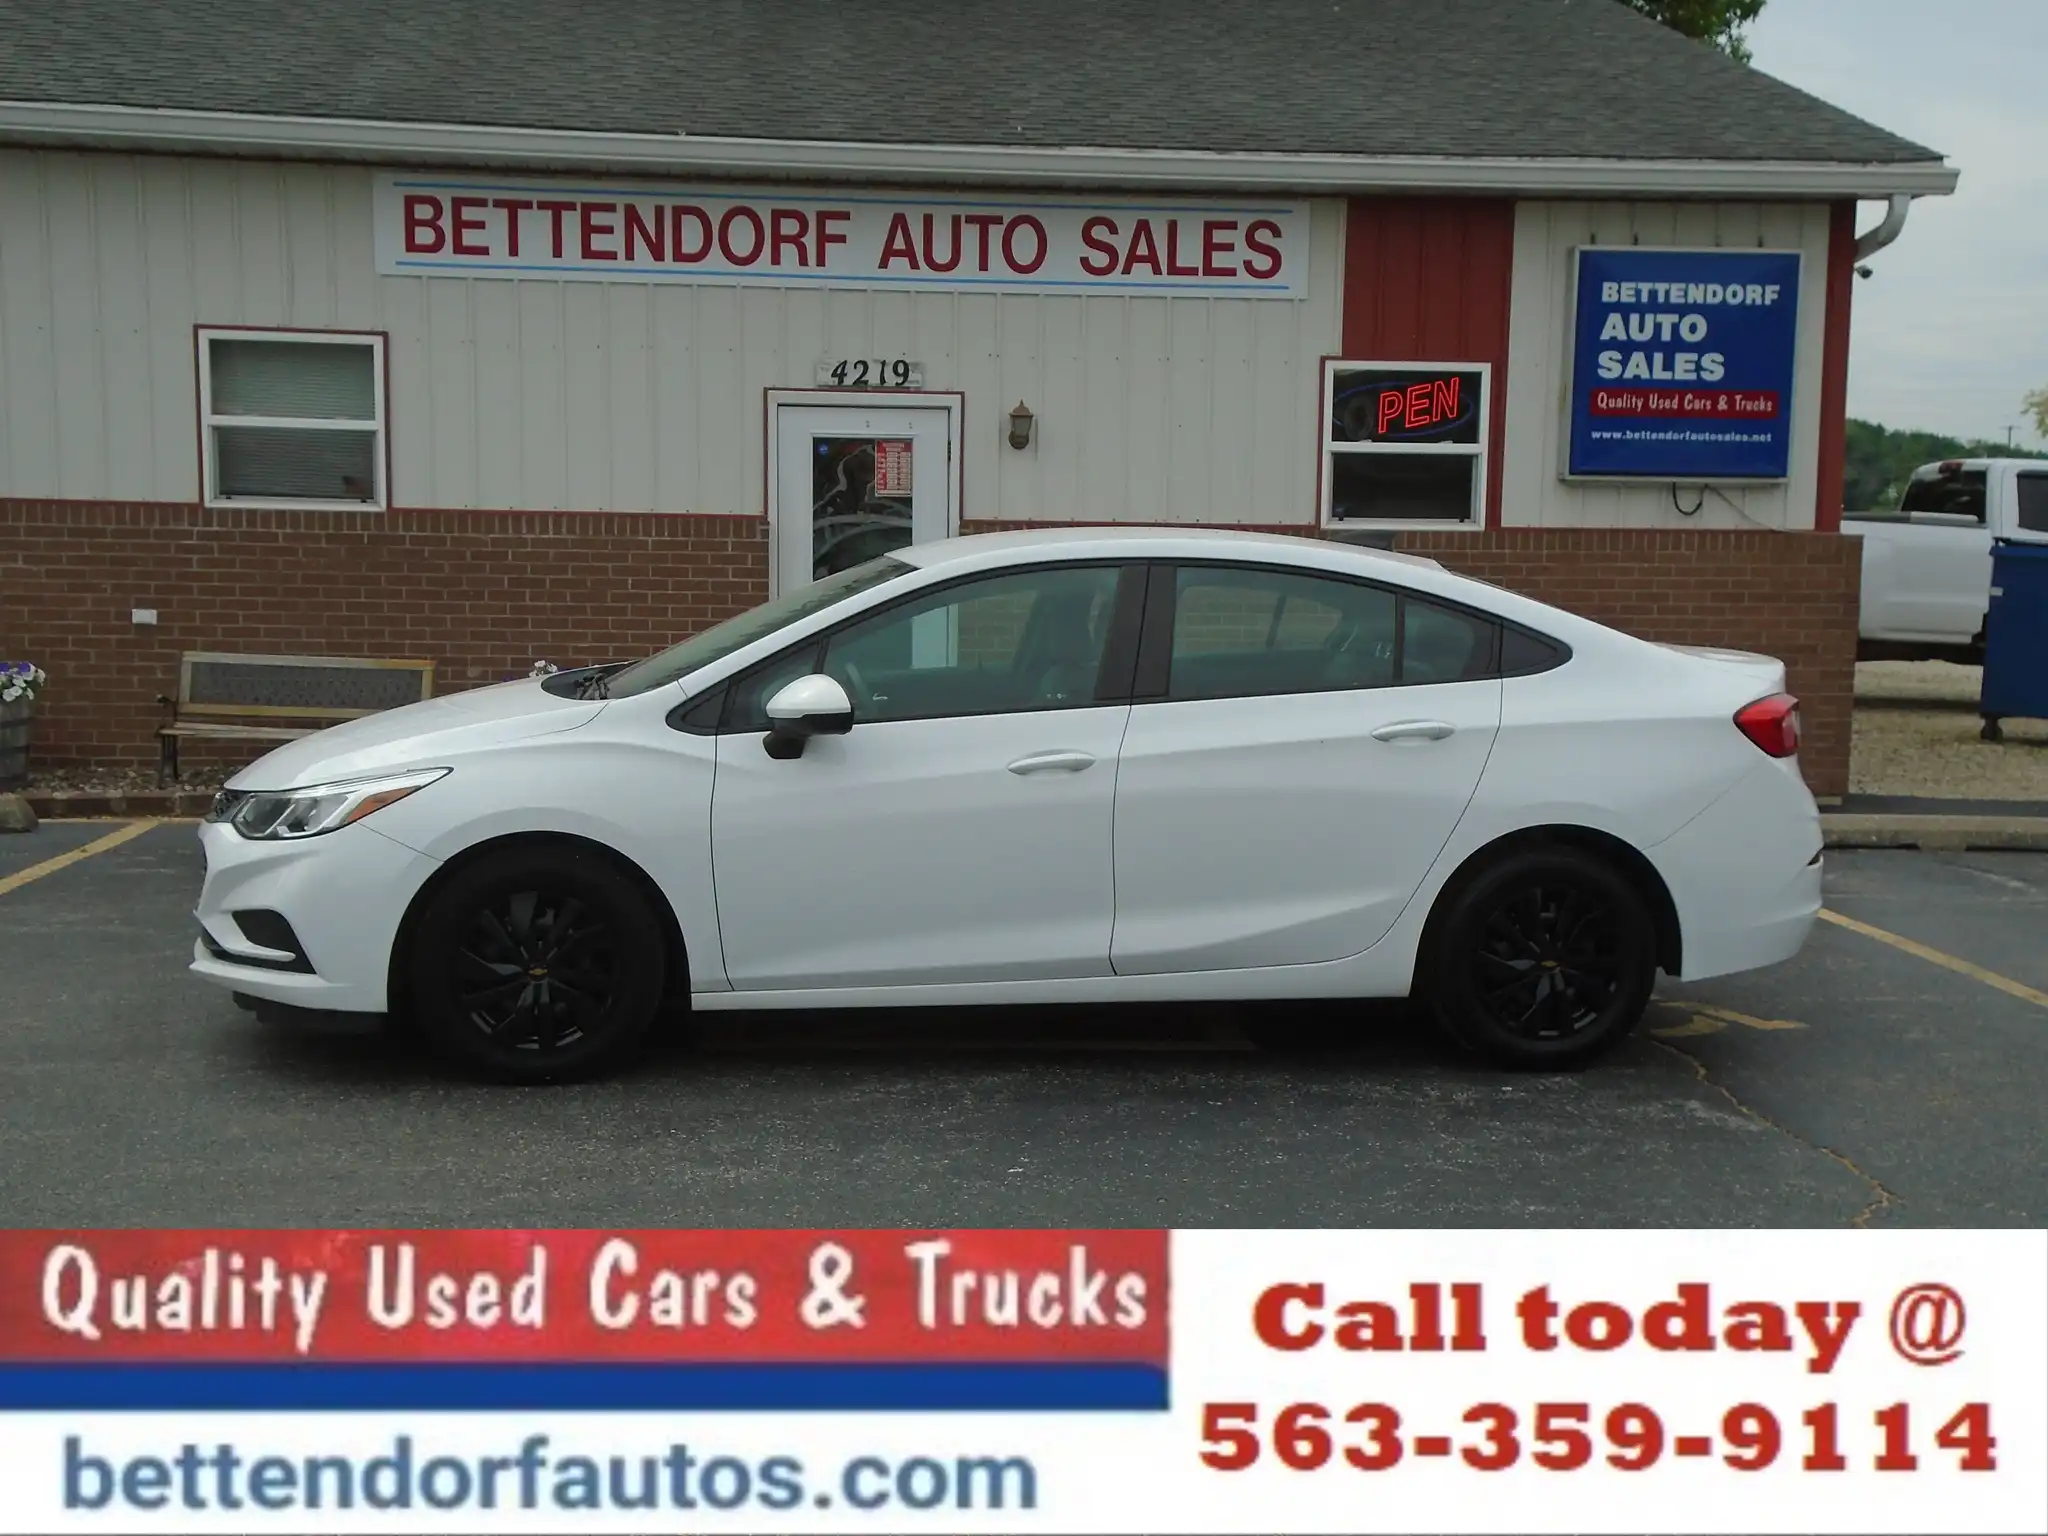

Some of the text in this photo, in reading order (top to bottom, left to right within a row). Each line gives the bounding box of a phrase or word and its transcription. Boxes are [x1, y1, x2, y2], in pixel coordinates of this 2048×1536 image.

[403, 194, 1282, 279] BETTENDORF AUTO SALES
[1601, 282, 1780, 305] BETTENDORF
[1600, 313, 1708, 342] AUTO
[831, 359, 910, 386] 4219
[1597, 350, 1725, 381] SALES
[1597, 391, 1773, 412] Quality Used Cars & Trucks
[1591, 430, 1772, 442] www.bettendorfautosales.net
